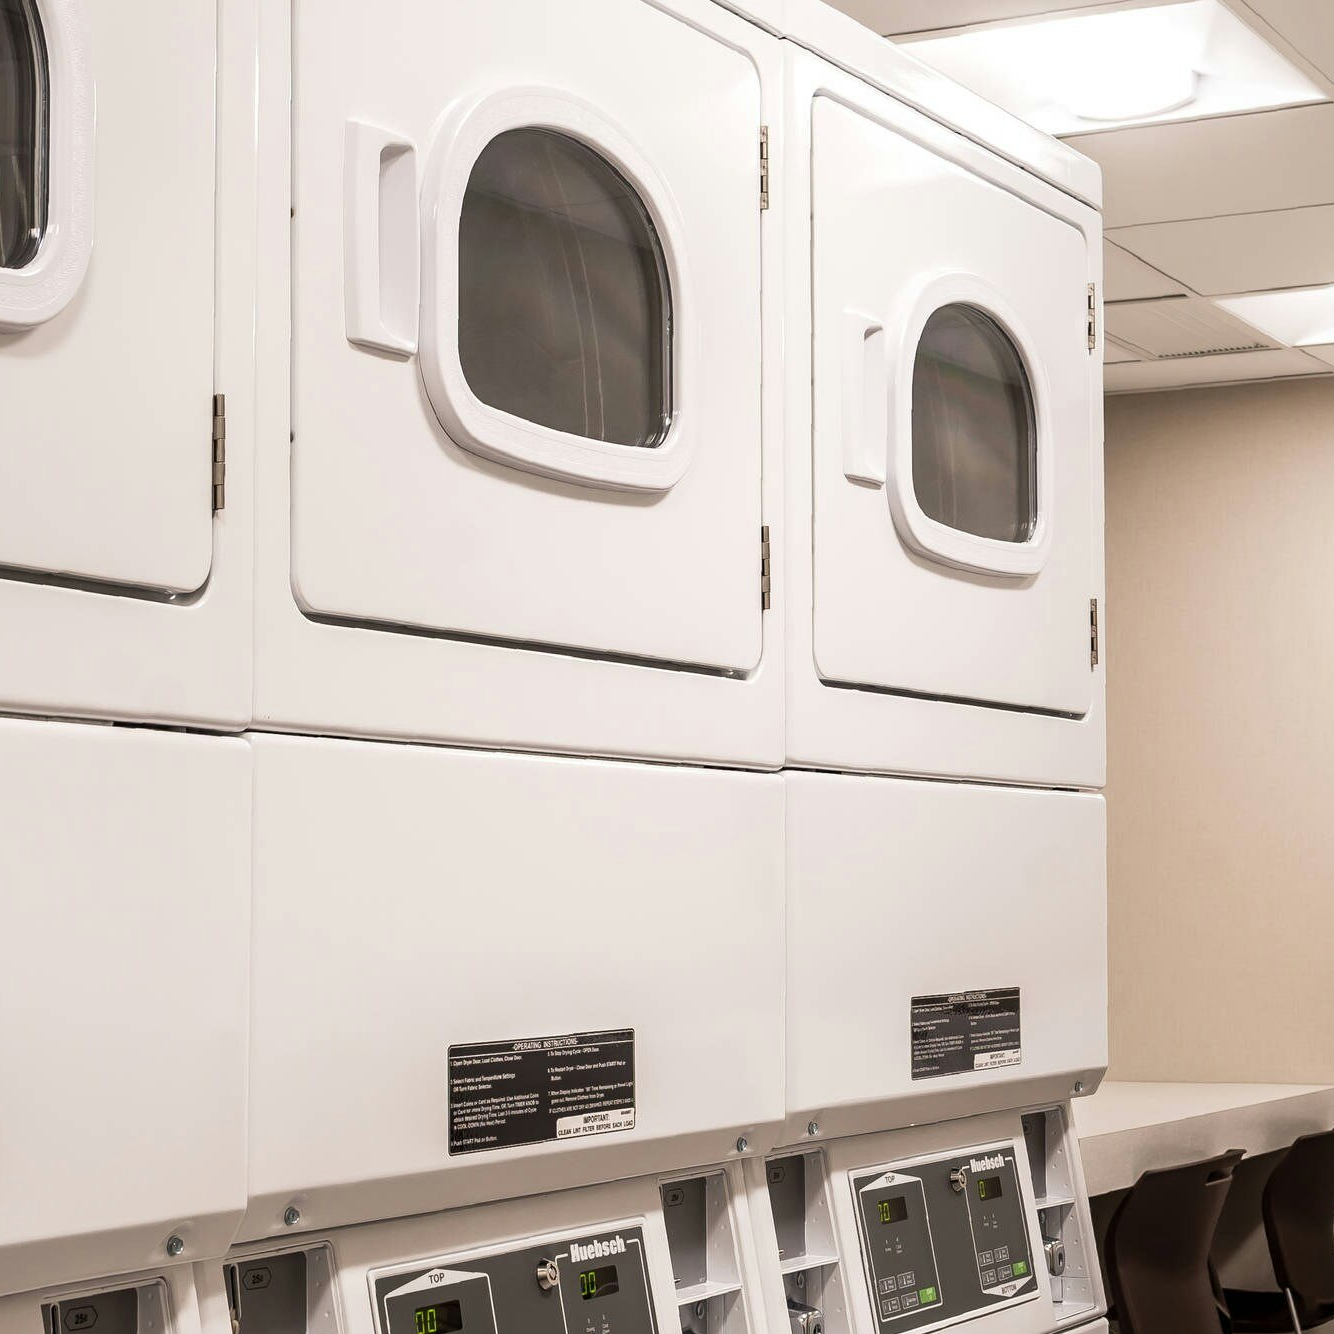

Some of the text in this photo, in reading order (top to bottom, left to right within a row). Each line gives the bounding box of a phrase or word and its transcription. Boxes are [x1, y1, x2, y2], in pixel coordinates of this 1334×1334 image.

[970, 1153, 1004, 1173] Huebsch
[885, 1175, 895, 1183] TOP
[570, 1235, 626, 1263] Huebsch
[429, 1273, 445, 1284] TOP
